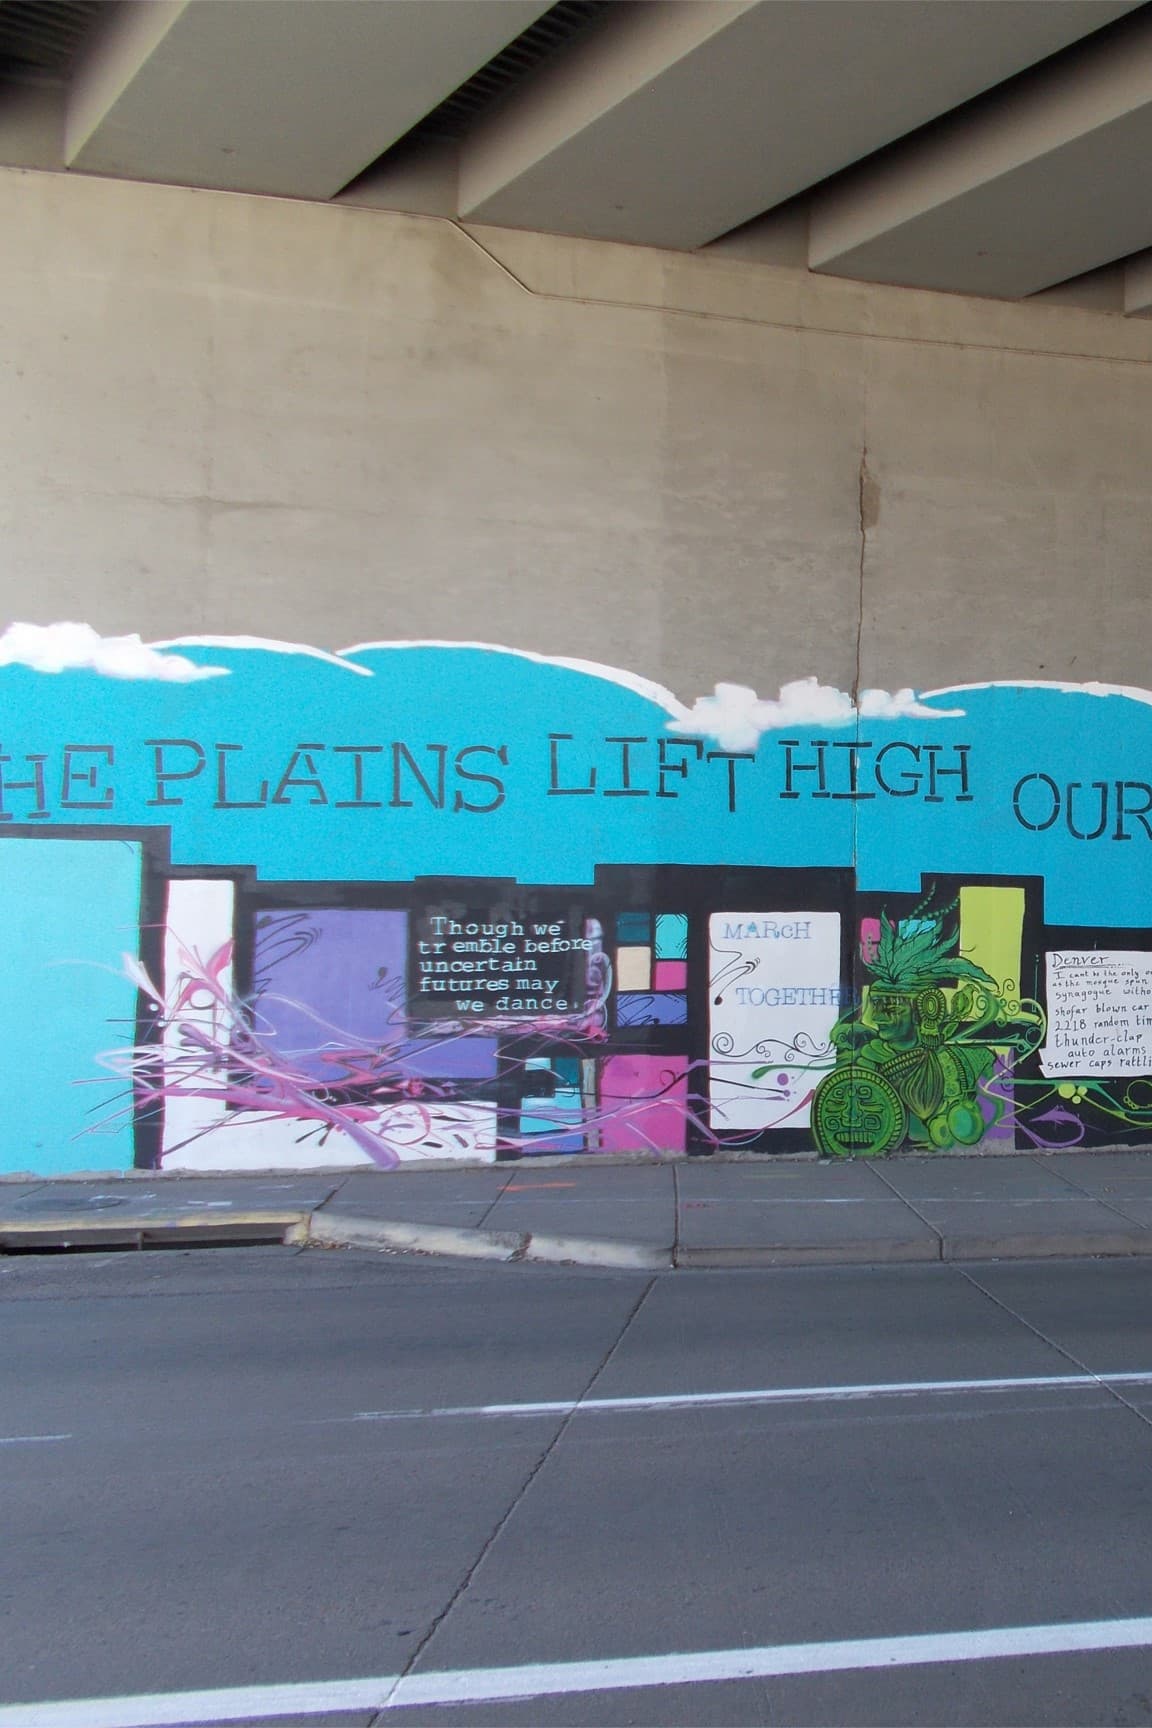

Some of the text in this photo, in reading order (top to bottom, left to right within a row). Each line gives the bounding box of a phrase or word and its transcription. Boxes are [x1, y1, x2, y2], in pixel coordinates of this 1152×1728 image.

[0, 744, 114, 819] HE
[145, 739, 508, 813] PLAINS
[547, 733, 755, 812] LIFT
[778, 740, 973, 802] HIGH
[430, 916, 561, 938] Though we
[524, 937, 593, 953] before
[419, 957, 538, 973] uncertain
[1121, 968, 1139, 979] only
[420, 977, 560, 994] futures may
[1125, 978, 1148, 986] spun
[1055, 989, 1112, 1002] synagogue
[456, 1000, 485, 1012] we
[1096, 1002, 1127, 1014] blown
[1132, 1004, 1149, 1012] car
[1055, 1019, 1087, 1032] 2218
[1094, 1016, 1130, 1029] random
[1055, 1029, 1143, 1048] thunder-clap
[1068, 1050, 1095, 1058] auto
[1103, 1044, 1146, 1057] alarms
[1047, 1060, 1082, 1071] sewer
[1089, 1060, 1112, 1070] caps
